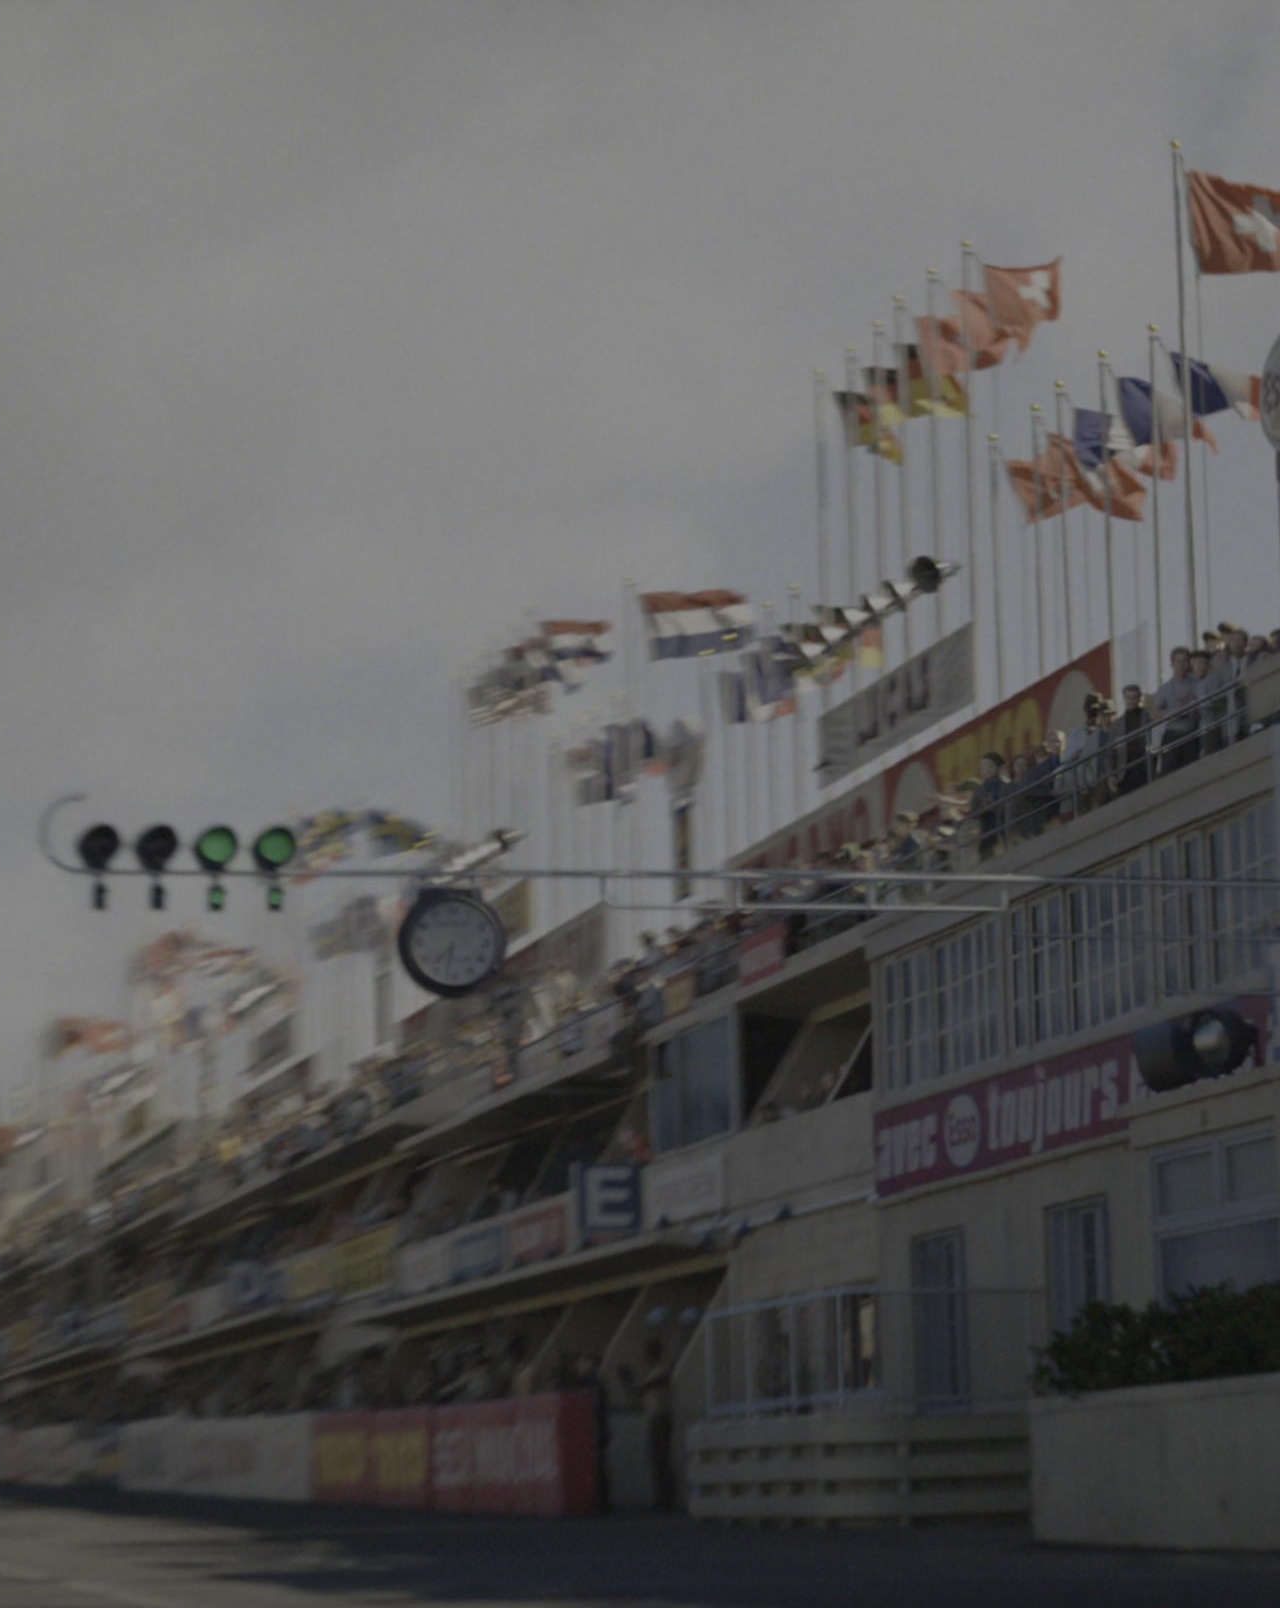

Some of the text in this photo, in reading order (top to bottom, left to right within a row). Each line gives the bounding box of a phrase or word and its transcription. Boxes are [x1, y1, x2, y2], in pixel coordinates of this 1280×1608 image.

[876, 1113, 938, 1181] avec
[987, 1060, 1119, 1155] toujours
[585, 1166, 634, 1228] E
